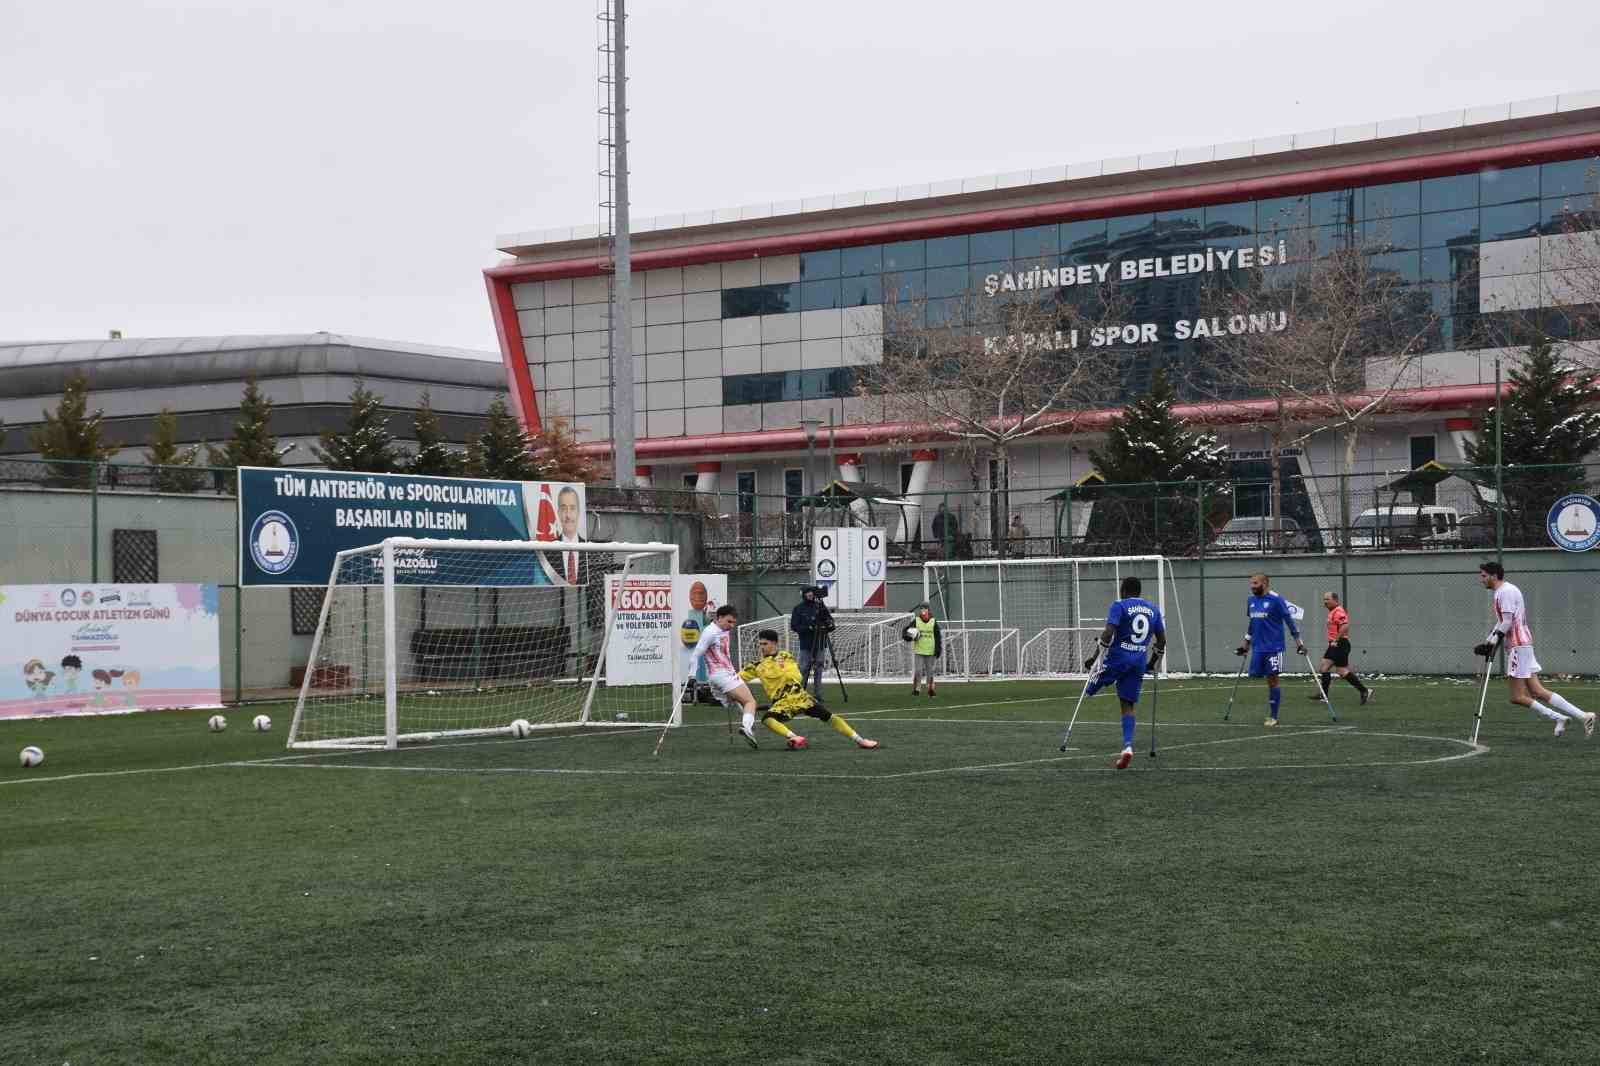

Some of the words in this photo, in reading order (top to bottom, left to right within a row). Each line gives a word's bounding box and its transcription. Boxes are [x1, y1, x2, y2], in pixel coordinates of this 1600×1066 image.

[984, 262, 1112, 297] ŞAHİNBEY
[1120, 239, 1289, 281] BELEDİYESİ
[1090, 323, 1159, 348] SPOR
[1174, 310, 1289, 340] SALONU
[274, 474, 306, 498] TÜM
[309, 478, 386, 500] ANTRENÖR
[388, 486, 404, 500] ve
[407, 483, 517, 506] SPORCULARIMIZA
[336, 508, 414, 530] BAŞARILAR
[416, 508, 467, 531] DİLERİM
[820, 535, 832, 550] 0
[868, 535, 880, 550] 0
[371, 558, 438, 569] TAMAZOĞLU
[15, 609, 53, 622] DÜNYA
[55, 609, 90, 623] ÇOCUK
[93, 607, 141, 621] ATLETİZM
[143, 607, 171, 620] GÜNÜ
[1130, 613, 1150, 644] 9
